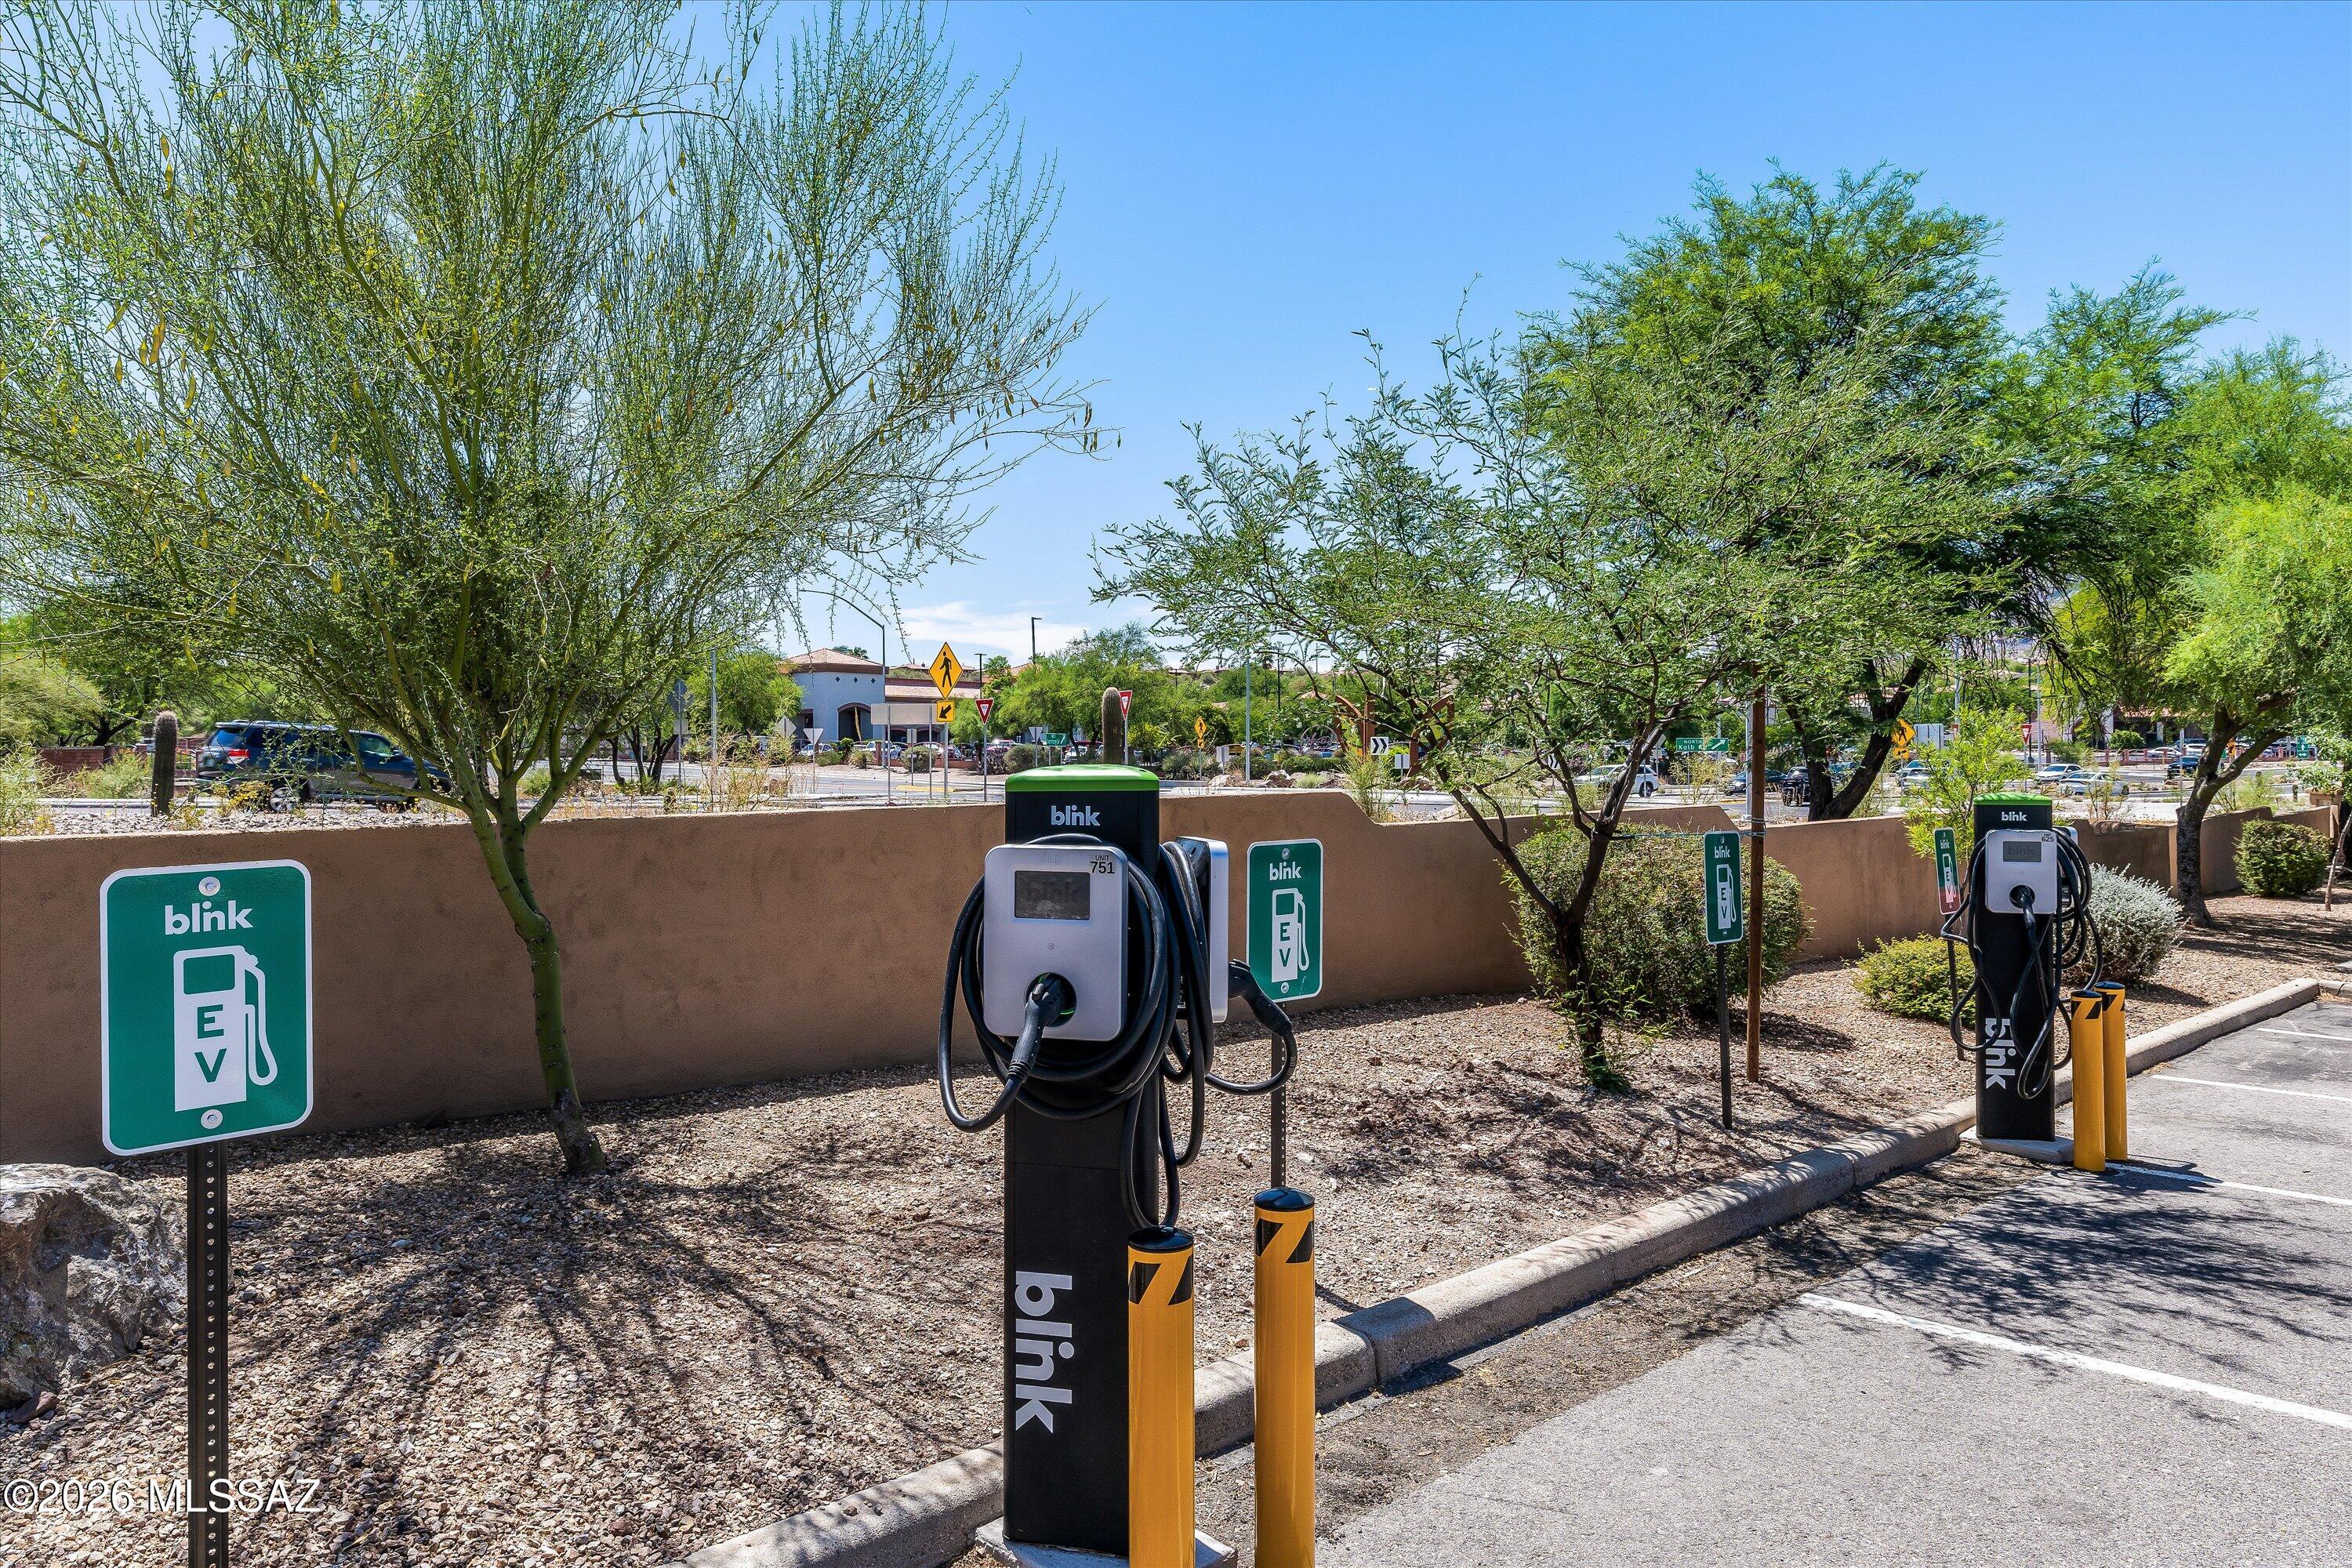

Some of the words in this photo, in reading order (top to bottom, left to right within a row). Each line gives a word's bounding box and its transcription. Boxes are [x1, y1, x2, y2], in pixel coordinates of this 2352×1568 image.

[1051, 804, 1101, 826] blink
[2002, 811, 2027, 822] blink
[1714, 845, 1730, 858] blink
[1090, 861, 1115, 874] 751
[1269, 861, 1302, 881] blink
[165, 900, 253, 935] blink
[1014, 1270, 1075, 1434] blink
